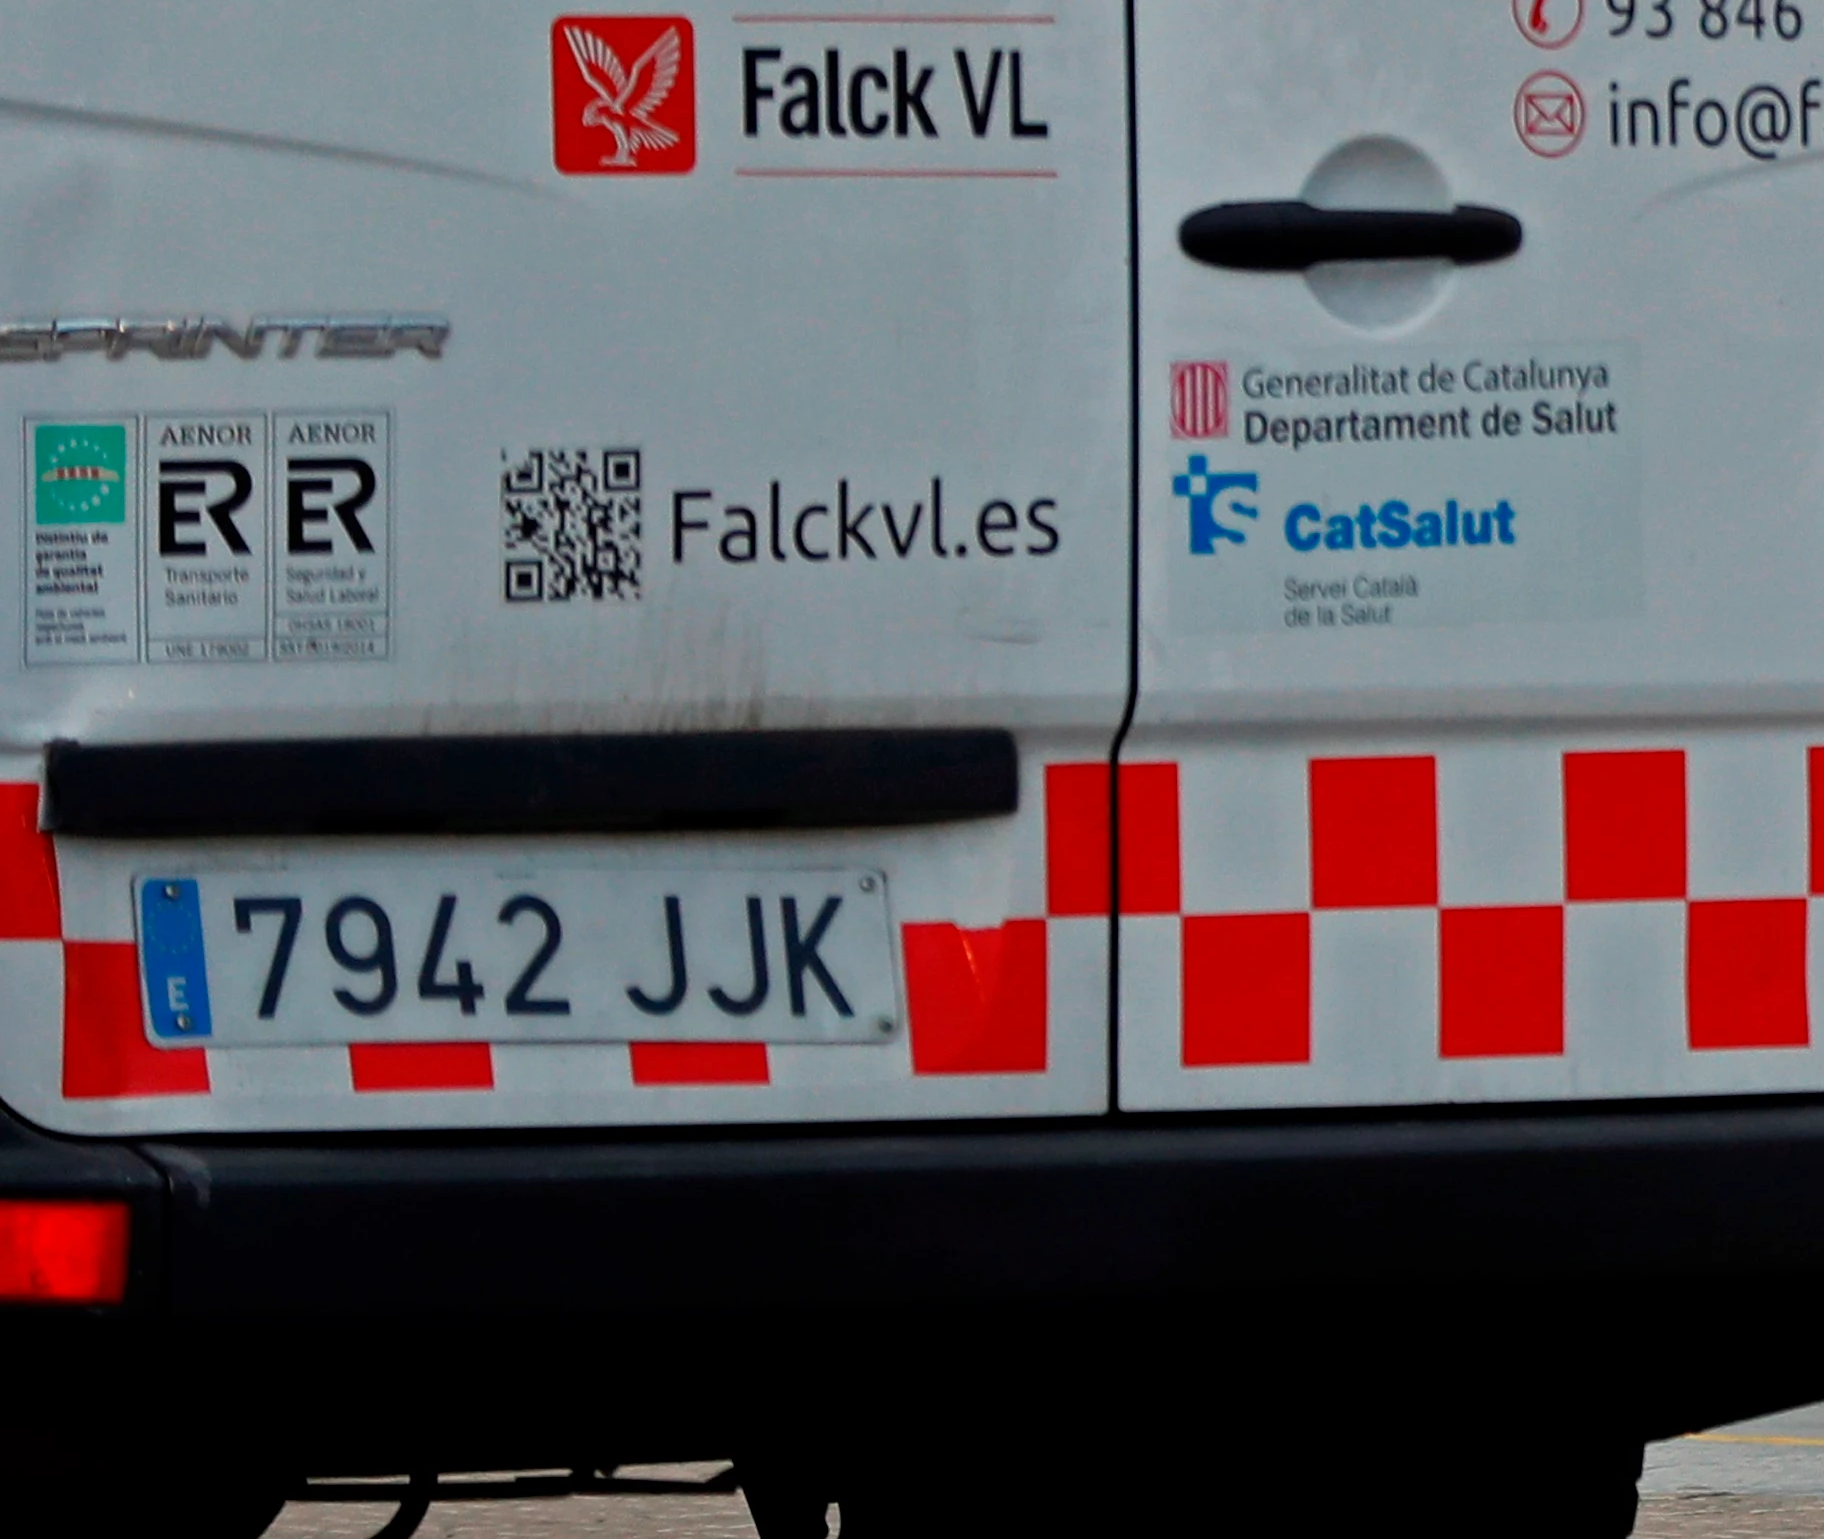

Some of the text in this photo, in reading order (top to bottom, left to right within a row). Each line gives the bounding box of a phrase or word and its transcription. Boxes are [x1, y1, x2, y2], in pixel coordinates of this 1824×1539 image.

[743, 47, 1048, 139] Falck VL
[1242, 357, 1609, 400] Generalitat de Catalunya
[159, 424, 253, 446] AENOR
[288, 423, 377, 445] AENOR
[1244, 399, 1618, 451] Departament de Salut
[672, 476, 1060, 562] Falckvl.es
[1285, 499, 1516, 553] CatSalut
[165, 567, 250, 584] Transporte
[1284, 572, 1419, 602] Servei Català
[165, 588, 238, 606] Sanitario
[1284, 602, 1392, 629] de la Salut
[234, 894, 855, 1019] 7942 JJK
[168, 976, 187, 1013] E
